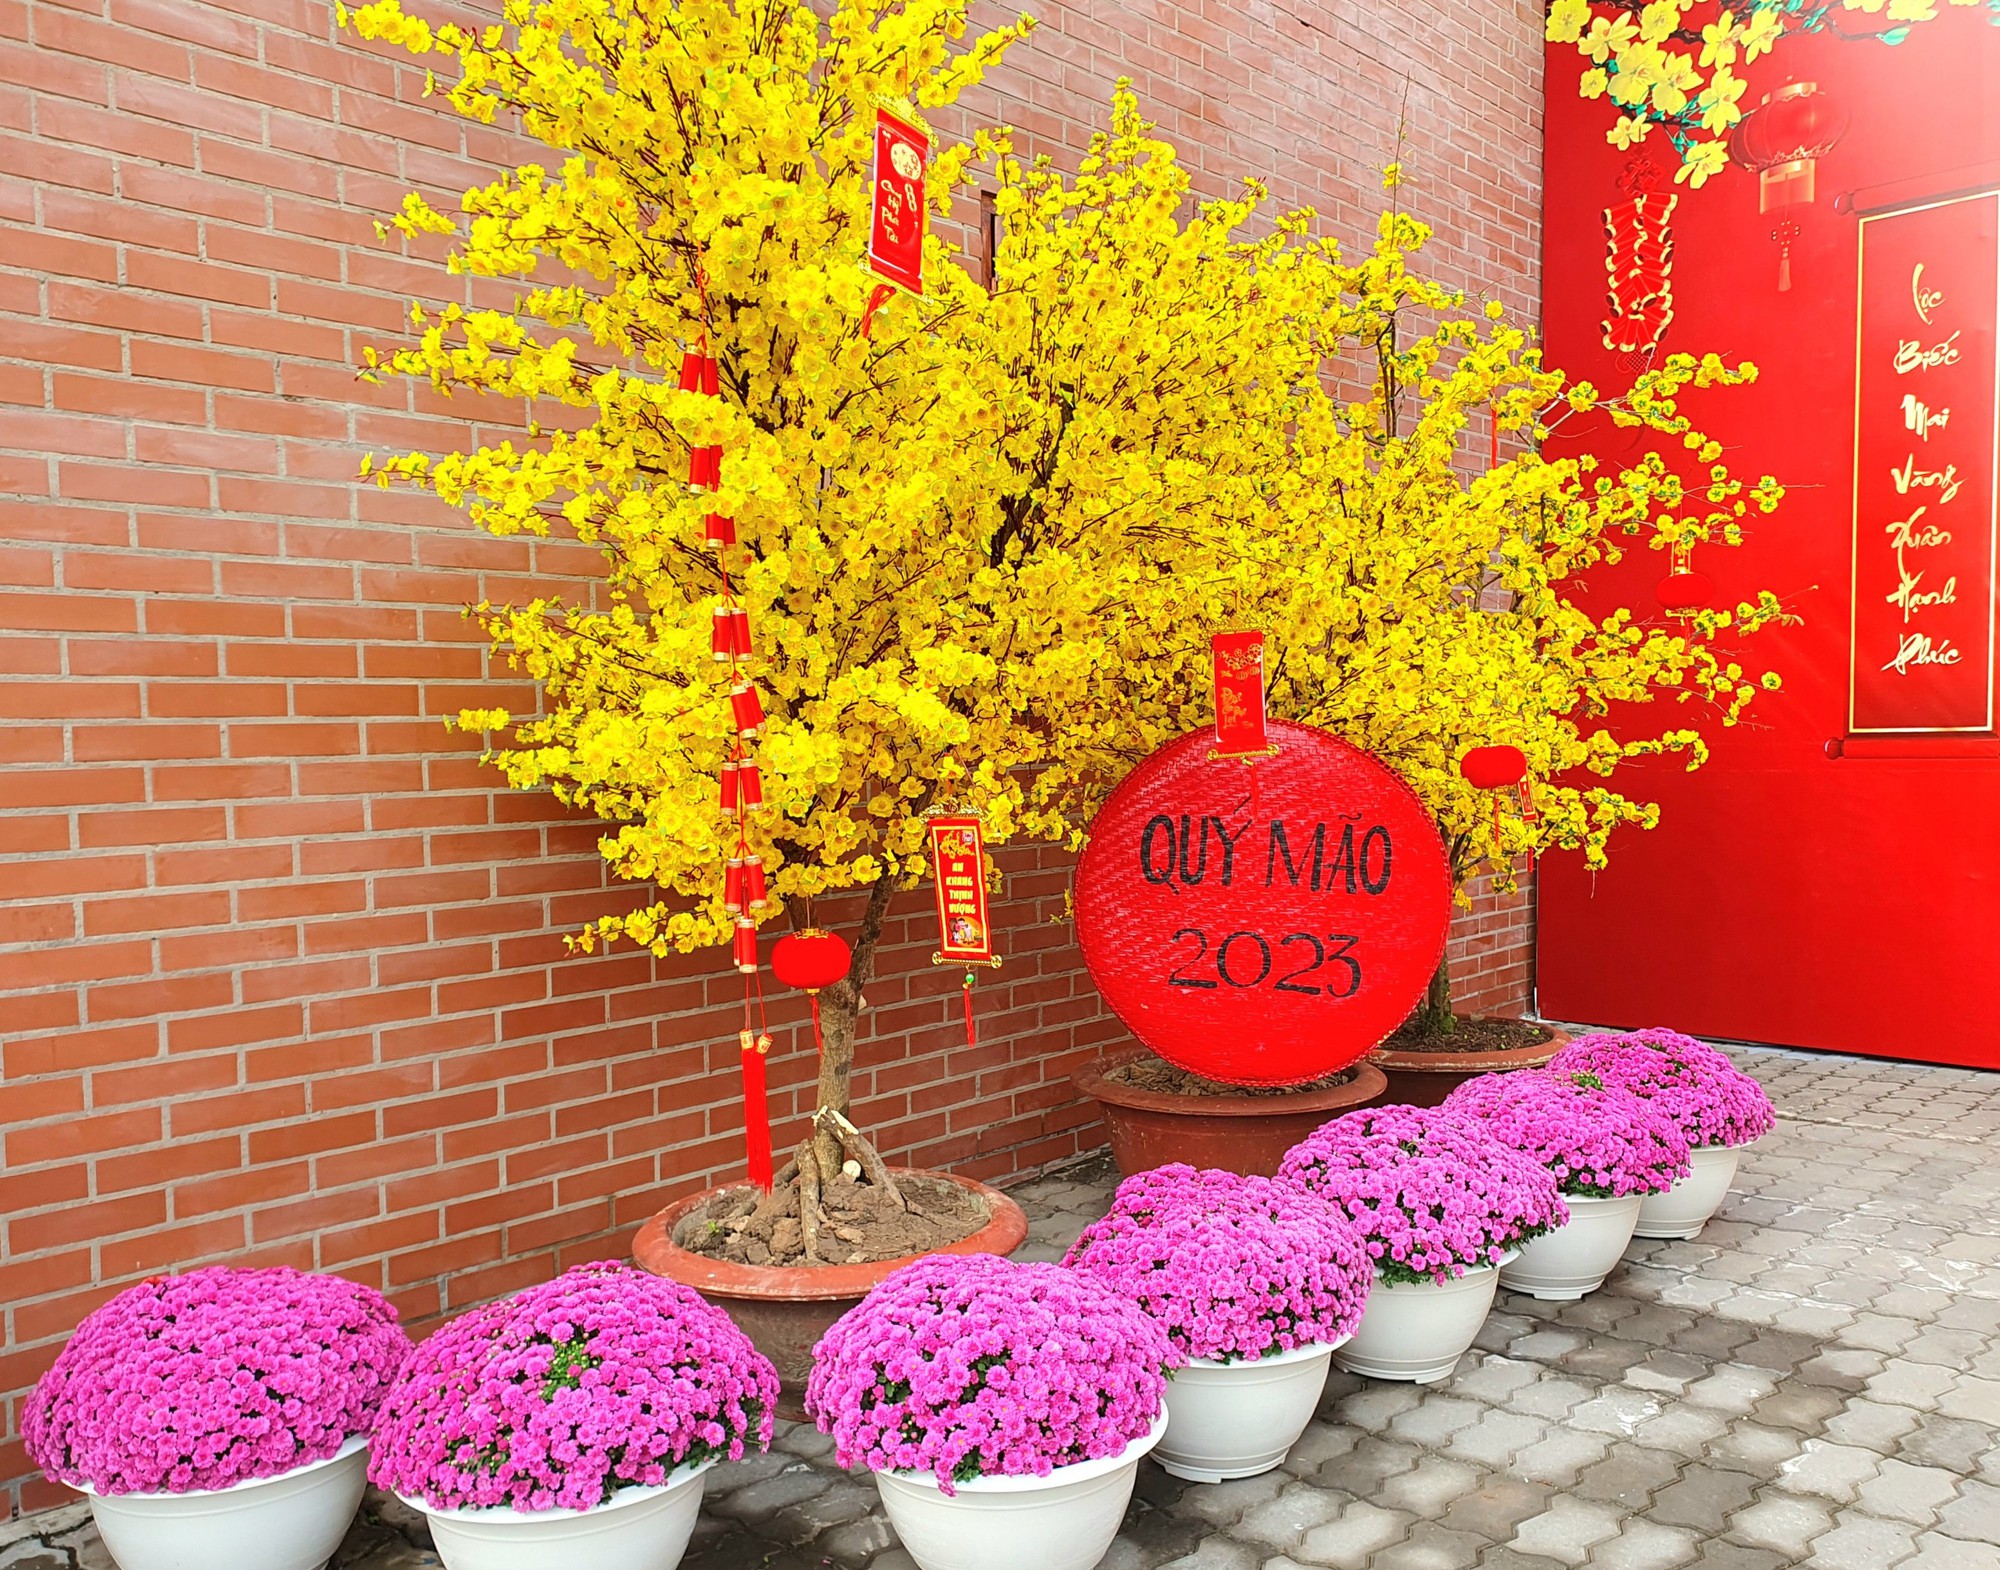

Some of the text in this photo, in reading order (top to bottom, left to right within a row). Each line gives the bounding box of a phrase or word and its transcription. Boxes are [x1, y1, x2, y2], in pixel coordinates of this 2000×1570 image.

[1911, 262, 1946, 325] Lộc
[1893, 330, 1962, 375] Biếc
[1900, 394, 1950, 442] Mai
[1891, 453, 1968, 504] Vàng
[1885, 506, 1952, 577] Xuân
[1885, 569, 1957, 624] Hạnh
[1880, 633, 1963, 675] Phúc
[952, 862, 964, 872] AN
[1140, 796, 1393, 895] QUÝ MÃO
[946, 876, 973, 887] KHANG
[948, 889, 974, 901] THỊNH
[948, 903, 976, 915] VƯỢNG
[1168, 928, 1361, 998] 2023
